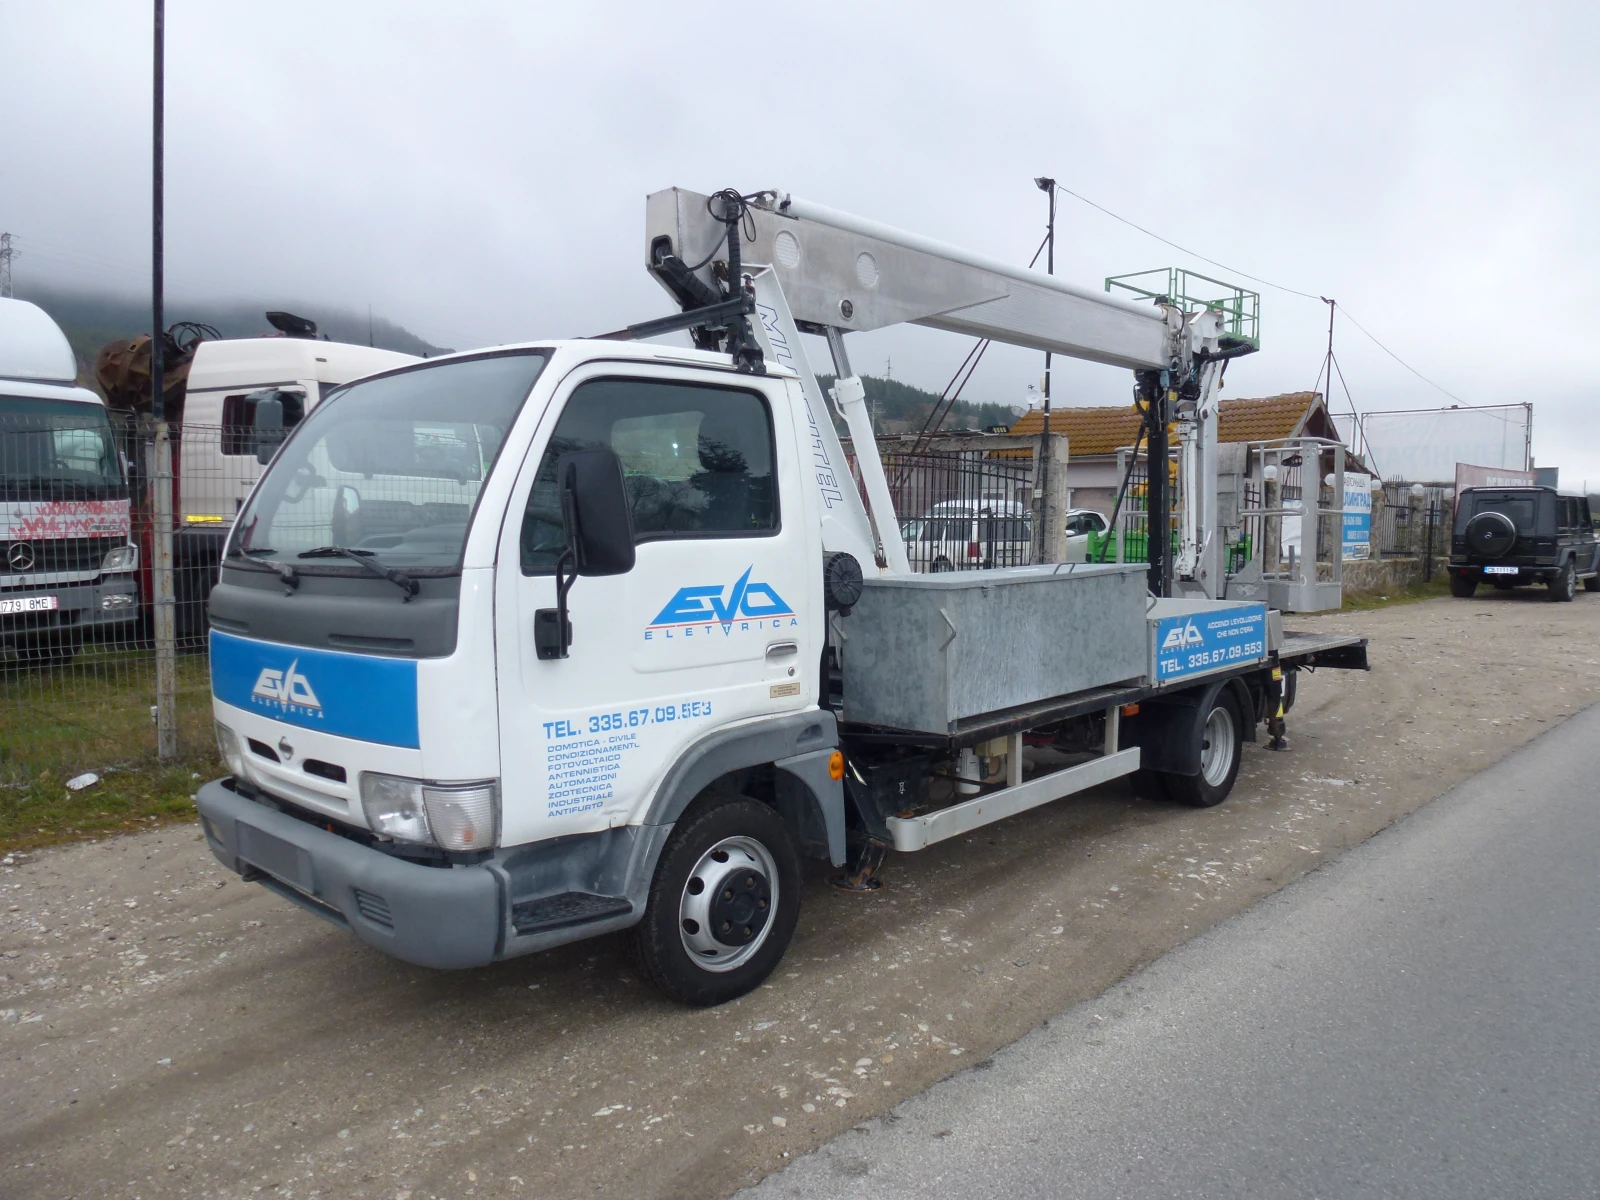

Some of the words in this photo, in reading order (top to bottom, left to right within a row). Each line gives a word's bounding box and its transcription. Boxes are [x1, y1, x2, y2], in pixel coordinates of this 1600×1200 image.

[650, 563, 794, 625] EVO
[644, 618, 798, 640] ELETTRICA
[1162, 617, 1203, 648] EVO
[1216, 630, 1227, 638] CHE
[1160, 658, 1184, 674] TEL.
[1188, 641, 1262, 668] 335.67.09.553
[253, 657, 321, 708] EVO
[543, 719, 582, 739] TEL.
[548, 739, 600, 753] DOMOTICA
[608, 733, 637, 743] CIVILE
[548, 754, 621, 771] FOTOVOLTAICO
[548, 763, 620, 781] ANTENNISTICA
[548, 773, 617, 790] AUTOMAZIONI
[548, 783, 612, 799] ZOOTECNICA
[548, 791, 613, 808] INDUSTRIALE
[548, 801, 603, 818] ANTIFURTO
